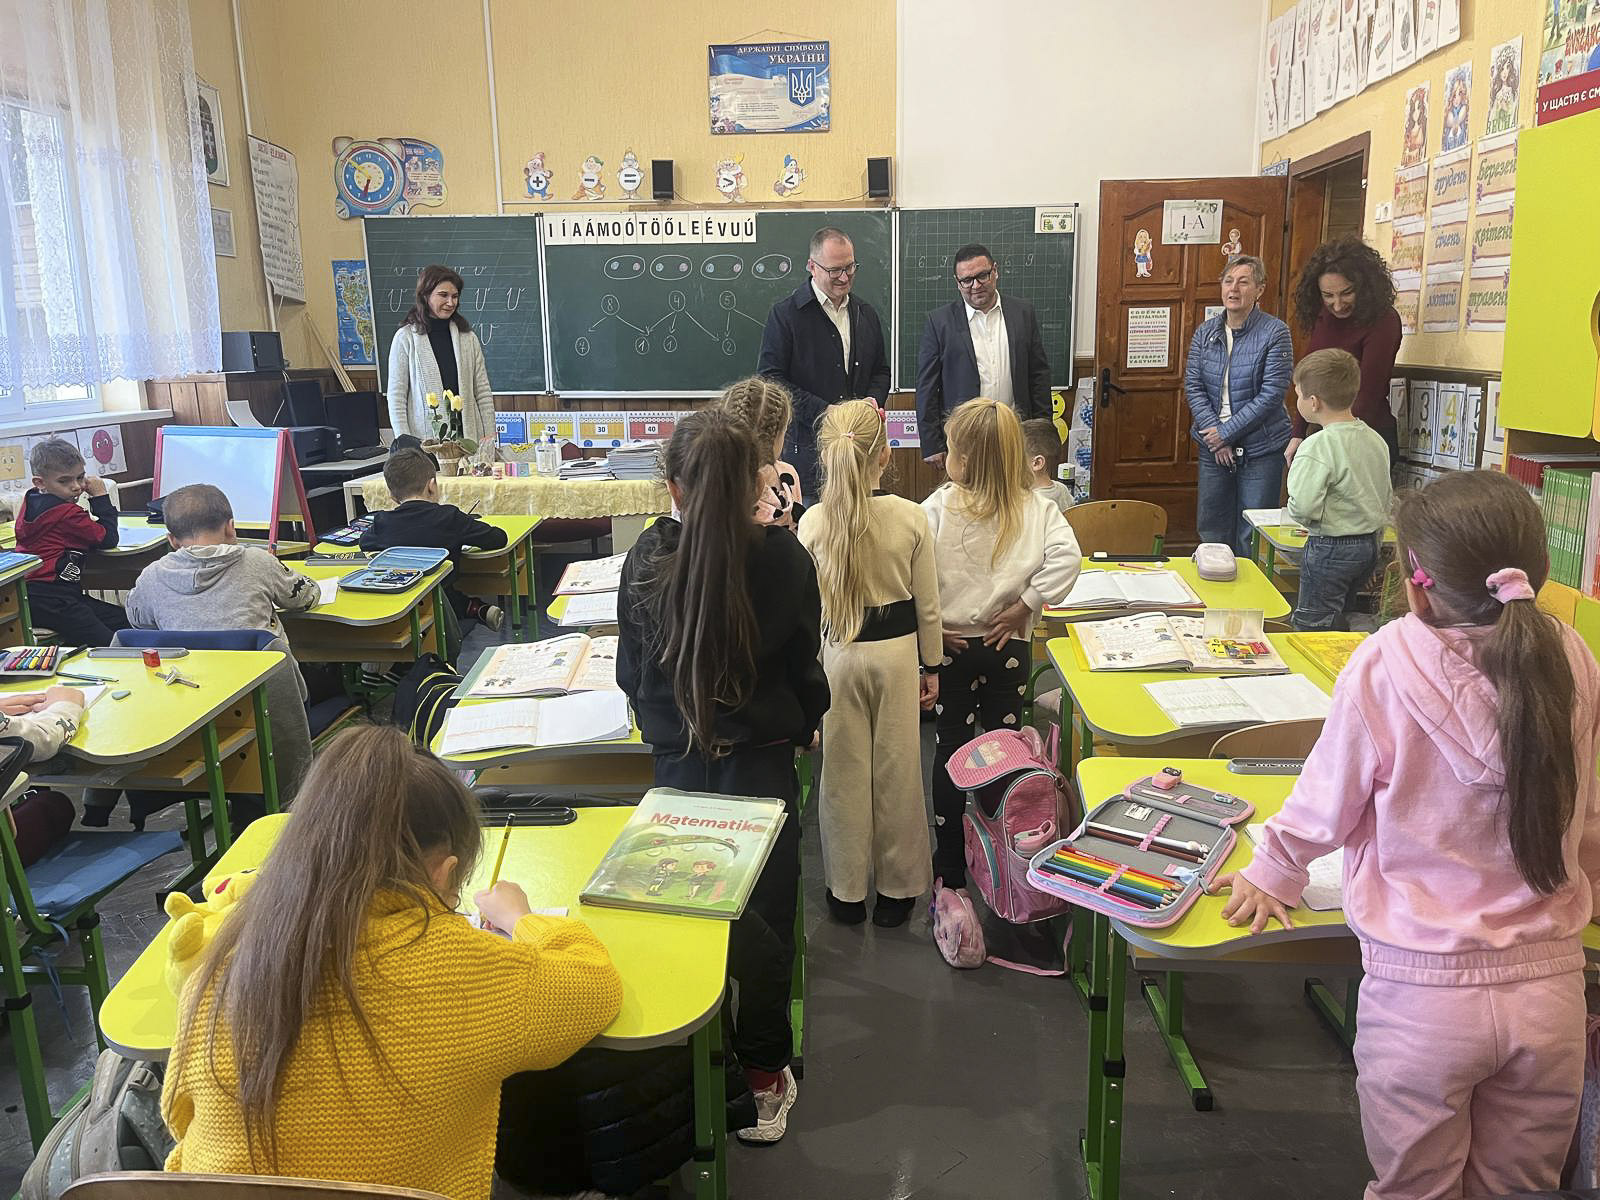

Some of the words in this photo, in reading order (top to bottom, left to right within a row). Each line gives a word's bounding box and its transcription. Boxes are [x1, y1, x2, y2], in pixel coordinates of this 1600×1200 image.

[737, 45, 780, 54] ДЕРЖАВНІ
[784, 44, 825, 52] СИМВОЛИ
[769, 52, 825, 64] УКРАЇНИ
[1542, 101, 1549, 112] У
[1549, 92, 1580, 110] ЩАСТЯ
[1581, 90, 1587, 101] Є
[1477, 158, 1517, 186] березен
[1420, 391, 1430, 422] 3
[1446, 393, 1457, 425] 4
[905, 424, 915, 433] 90
